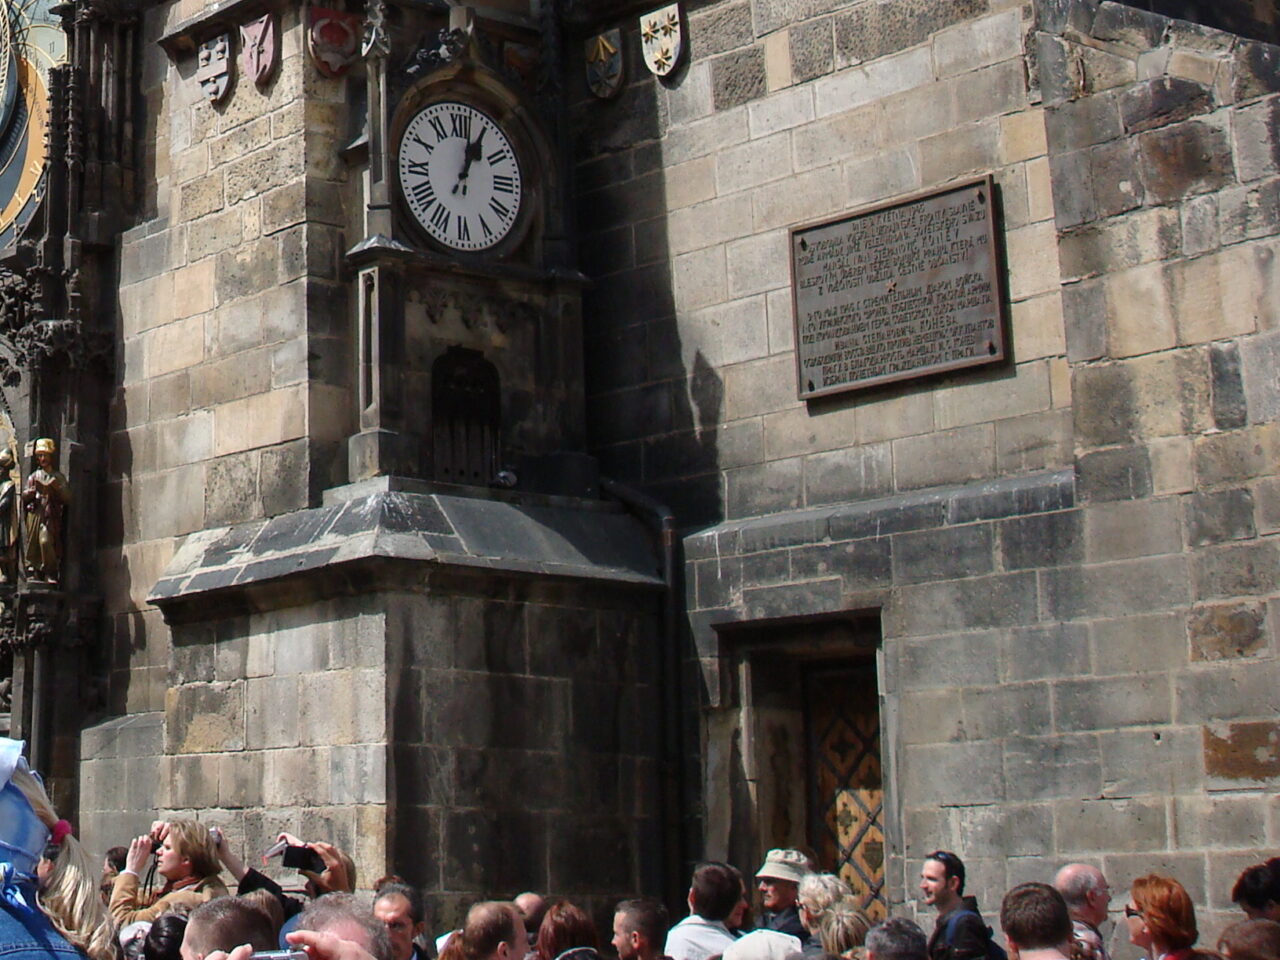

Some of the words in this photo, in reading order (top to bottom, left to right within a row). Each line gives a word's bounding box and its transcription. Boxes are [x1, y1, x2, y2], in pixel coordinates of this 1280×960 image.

[429, 116, 448, 142] XI
[450, 114, 471, 139] XII
[413, 135, 433, 154] X
[408, 160, 429, 176] IX
[487, 149, 507, 166] II
[412, 181, 437, 212] VIII
[494, 175, 514, 193] III
[430, 203, 450, 233] VII
[489, 197, 510, 222] IV
[458, 216, 470, 241] VI
[479, 214, 493, 238] V
